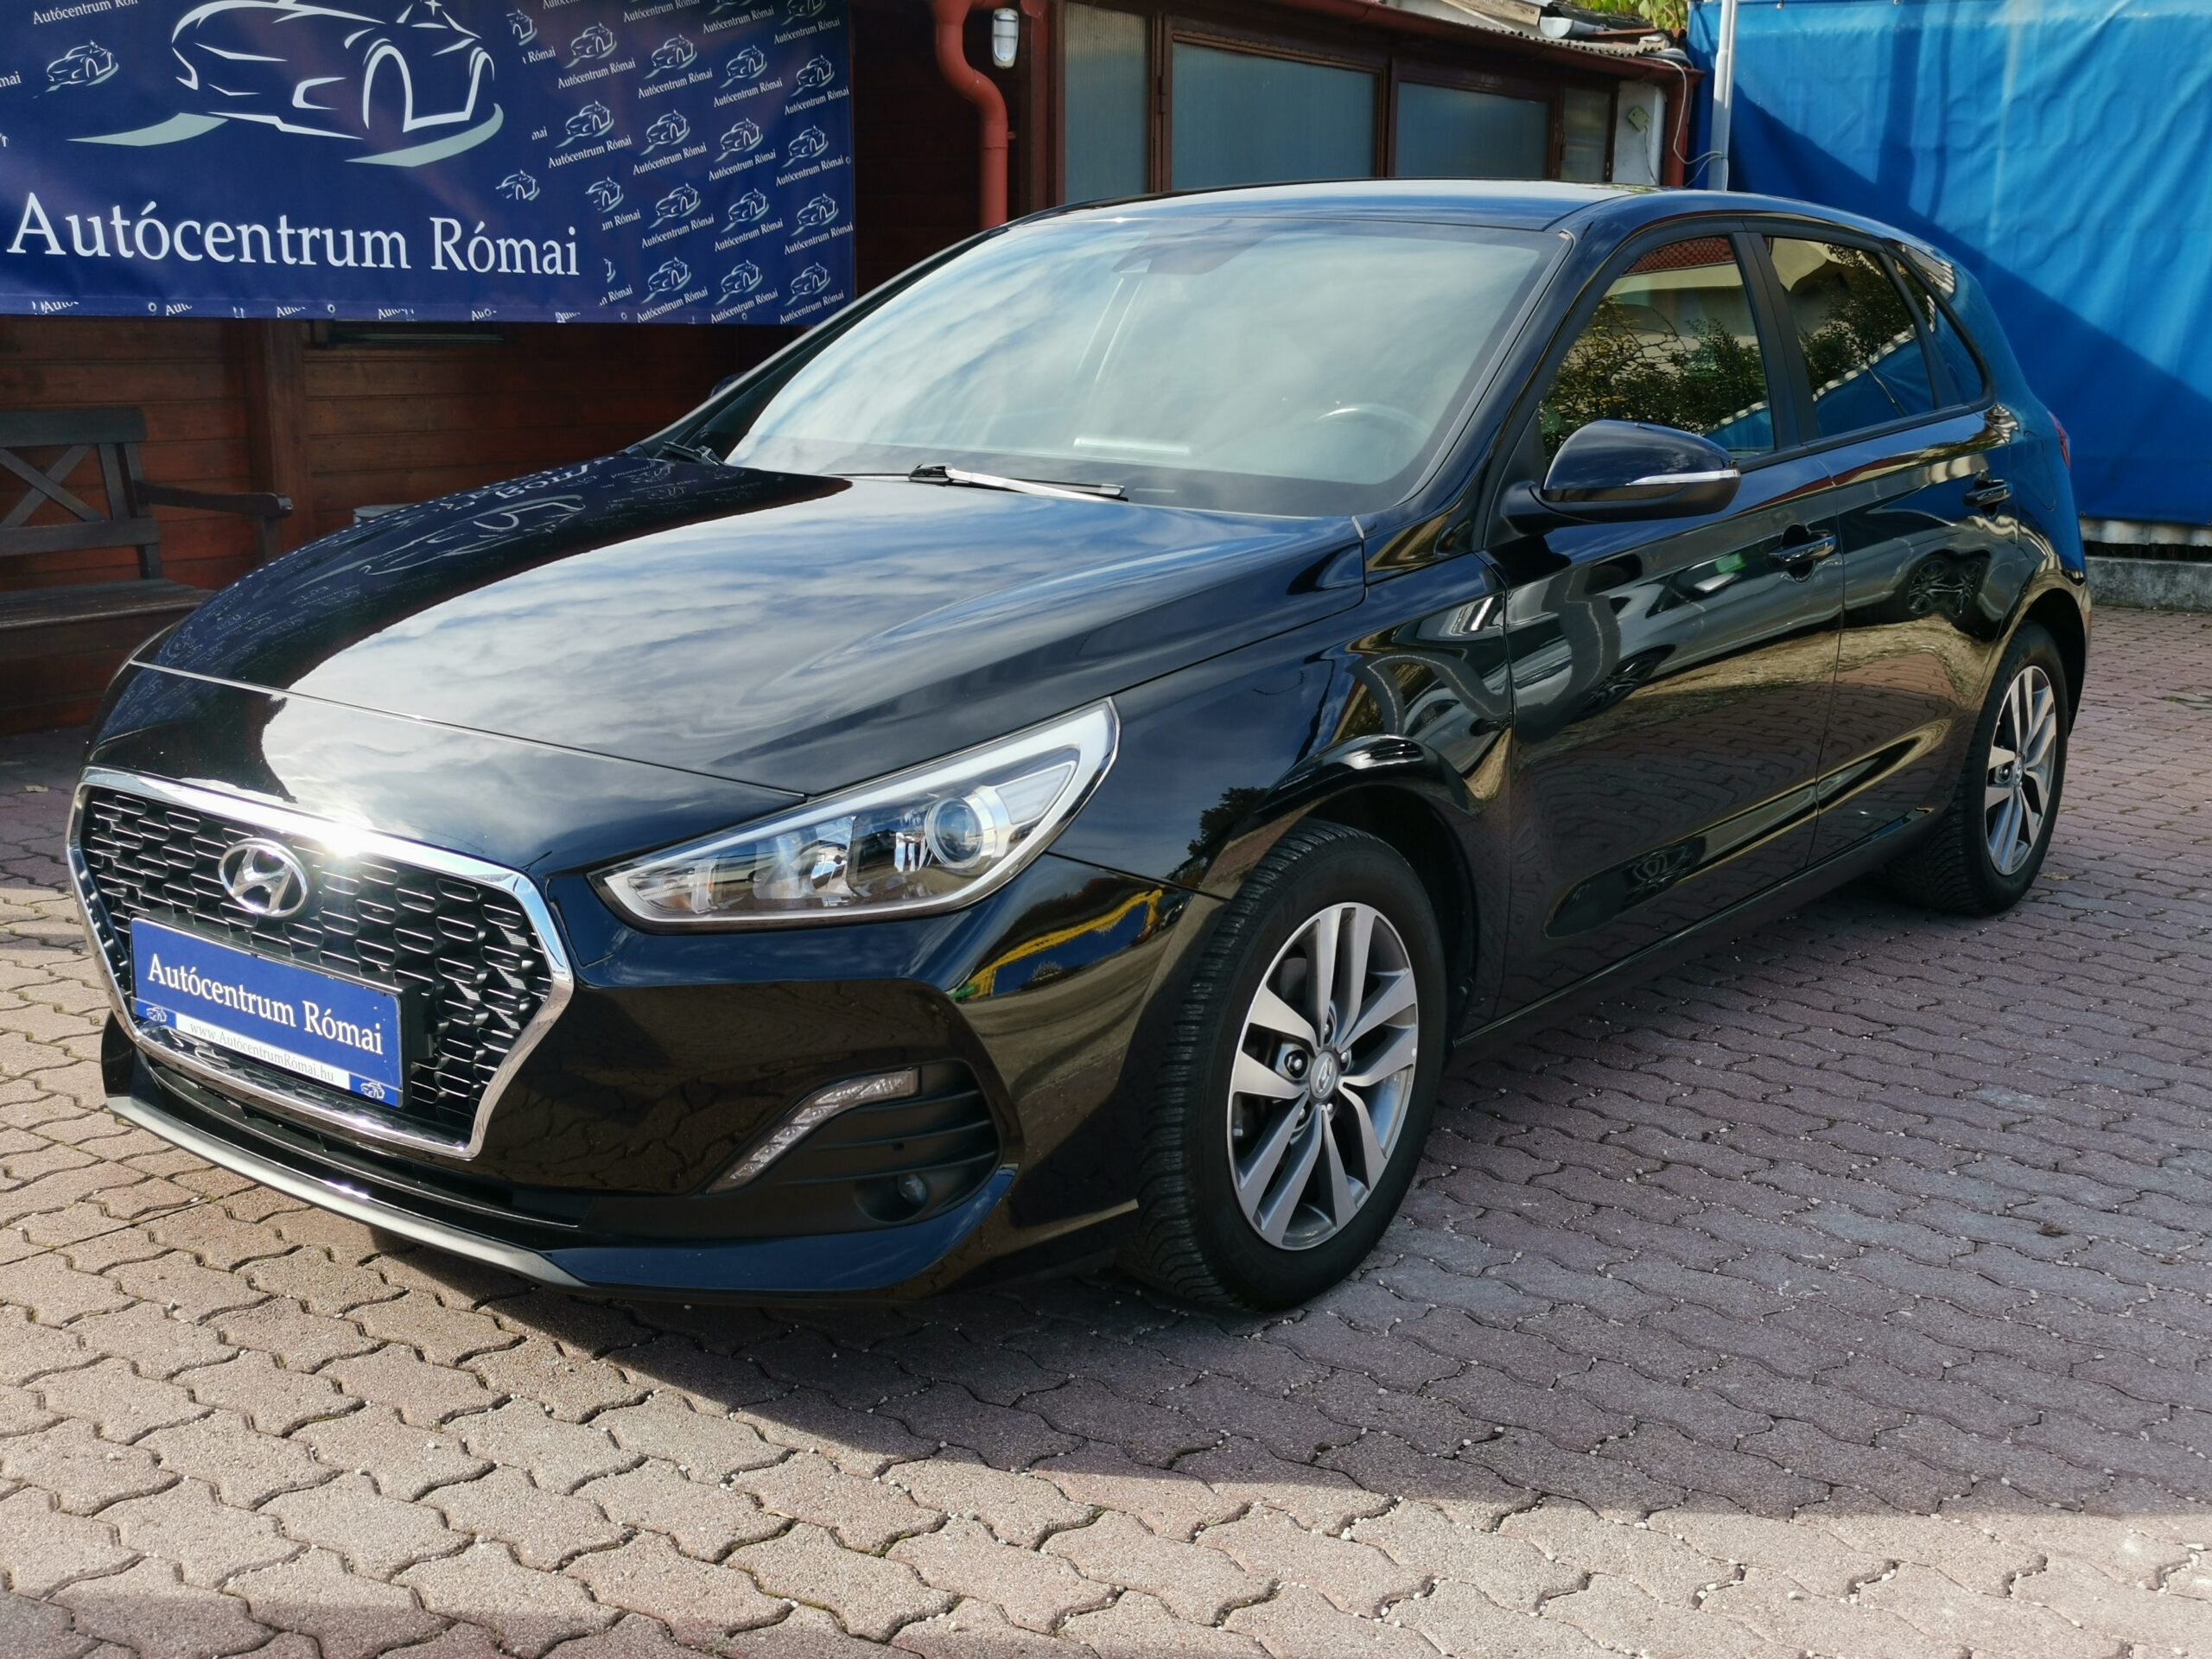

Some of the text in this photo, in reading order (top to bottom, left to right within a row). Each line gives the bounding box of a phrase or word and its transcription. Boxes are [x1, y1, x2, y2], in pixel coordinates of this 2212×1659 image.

[33, 1, 111, 25] Autócentrum
[702, 5, 774, 35] Autócentrum Római
[773, 16, 841, 45] Autócentrum Római
[528, 46, 556, 62] Római
[558, 58, 637, 89] Autócentrum Római
[638, 68, 713, 99] Autócentrum Római
[713, 77, 784, 108] Autócentrum Római
[785, 88, 849, 116] Autócentrum Római
[548, 135, 632, 168] Autócentrum Római
[632, 142, 708, 176] Autócentrum Római
[709, 149, 777, 181] Autócentrum Római
[776, 155, 844, 188] Autócentrum Római
[614, 208, 641, 226] Római
[641, 213, 715, 249] Autócentrum Római
[6, 191, 580, 276] Autócentrum Római
[715, 218, 784, 252] Autócentrum Római
[784, 223, 854, 255] Autócentrum Római
[607, 283, 632, 302] Római
[637, 285, 709, 323] Autócentrum Római
[710, 288, 779, 324] Autócentrum Római
[779, 291, 844, 325] Autócentrum Római
[147, 953, 384, 1056] Autócentrum Római
